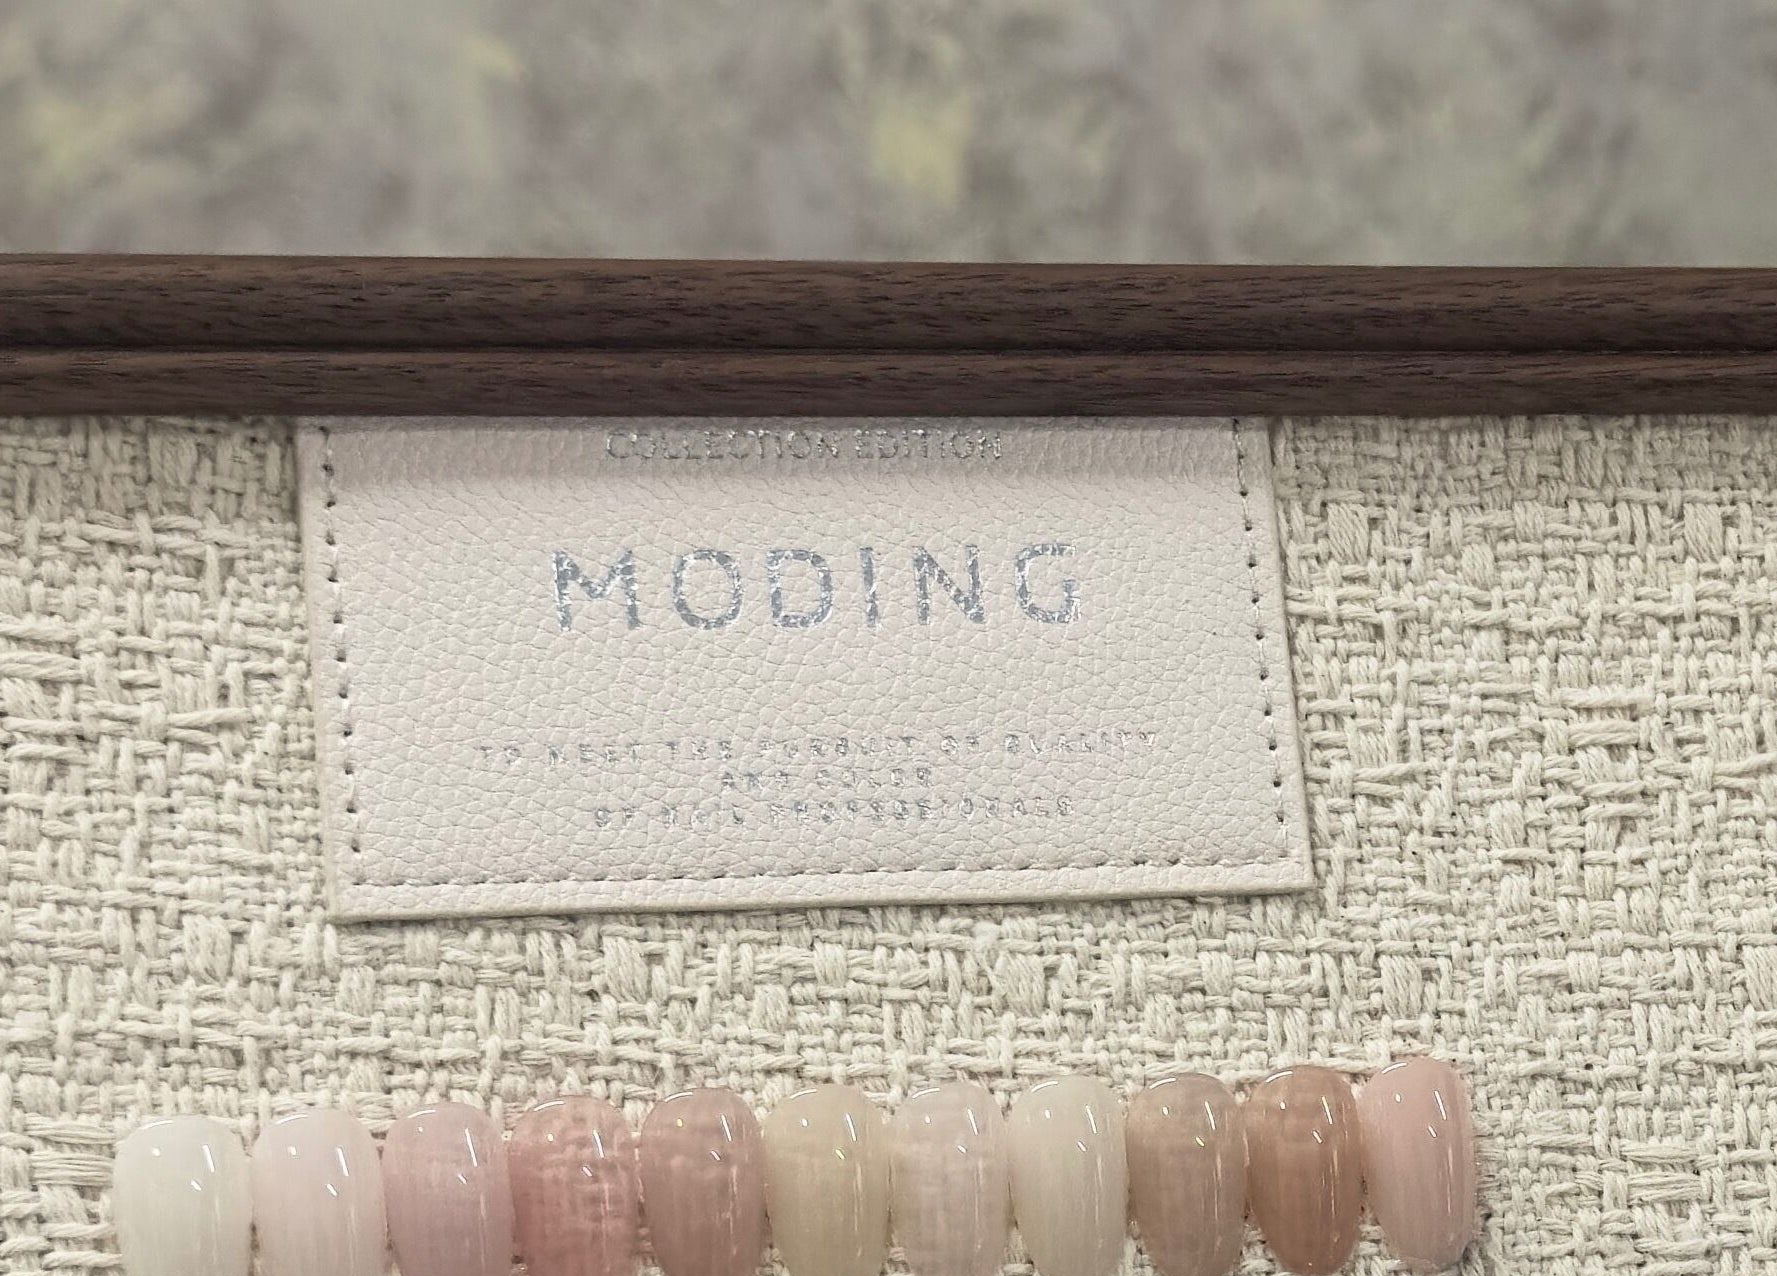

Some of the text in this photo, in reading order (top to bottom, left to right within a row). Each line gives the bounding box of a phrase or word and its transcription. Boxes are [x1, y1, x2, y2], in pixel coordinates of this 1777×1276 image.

[606, 429, 1002, 460] COLLECTION EDITION
[552, 543, 1082, 632] MODING
